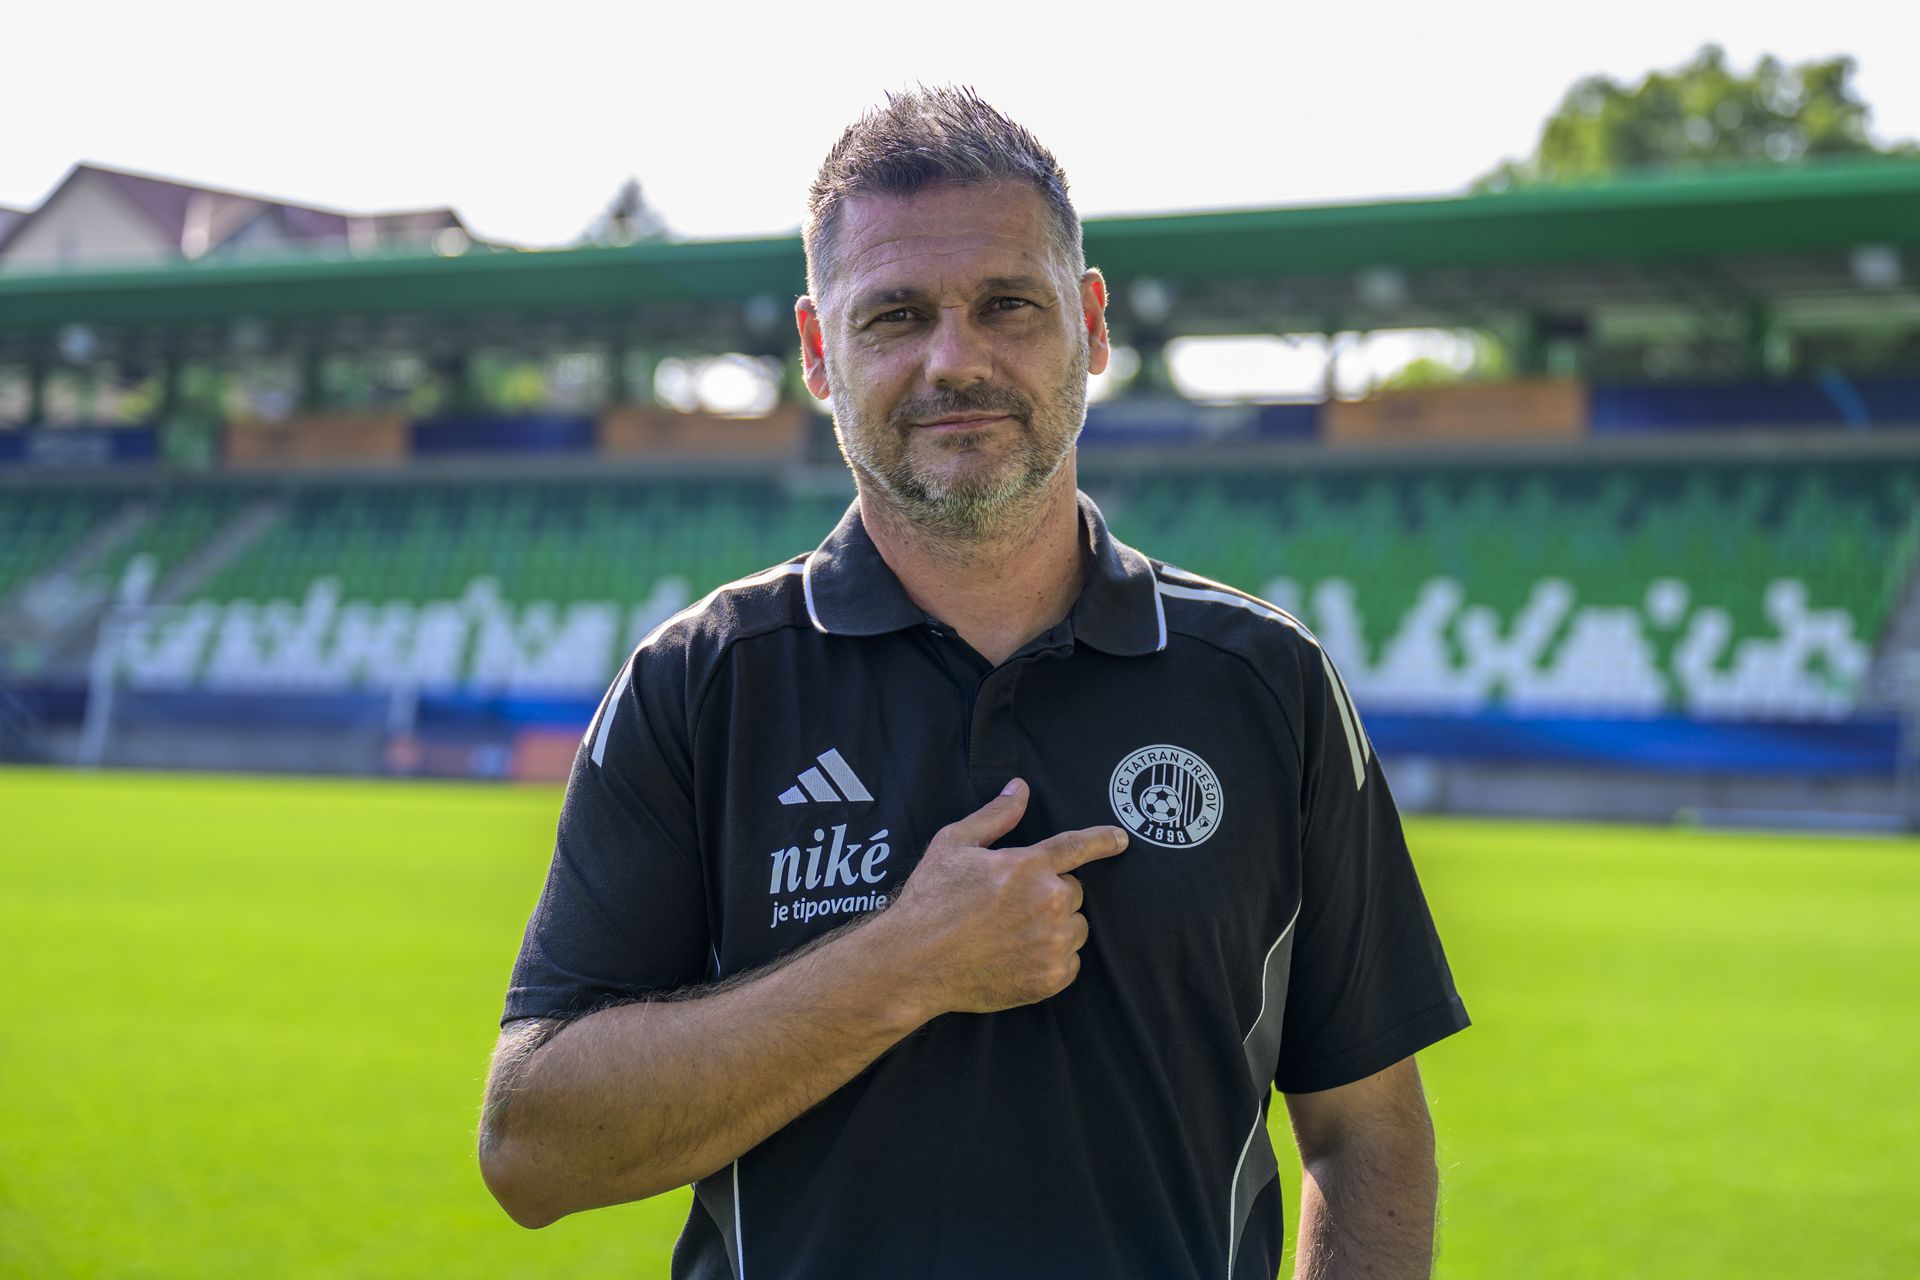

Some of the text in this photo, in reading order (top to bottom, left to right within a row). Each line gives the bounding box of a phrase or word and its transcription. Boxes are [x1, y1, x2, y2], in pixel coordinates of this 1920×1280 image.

[1117, 751, 1217, 811] FC TATRAN PREŠOV
[1144, 824, 1186, 843] 1898
[769, 823, 890, 895] niké
[771, 890, 888, 929] je tipovanie
